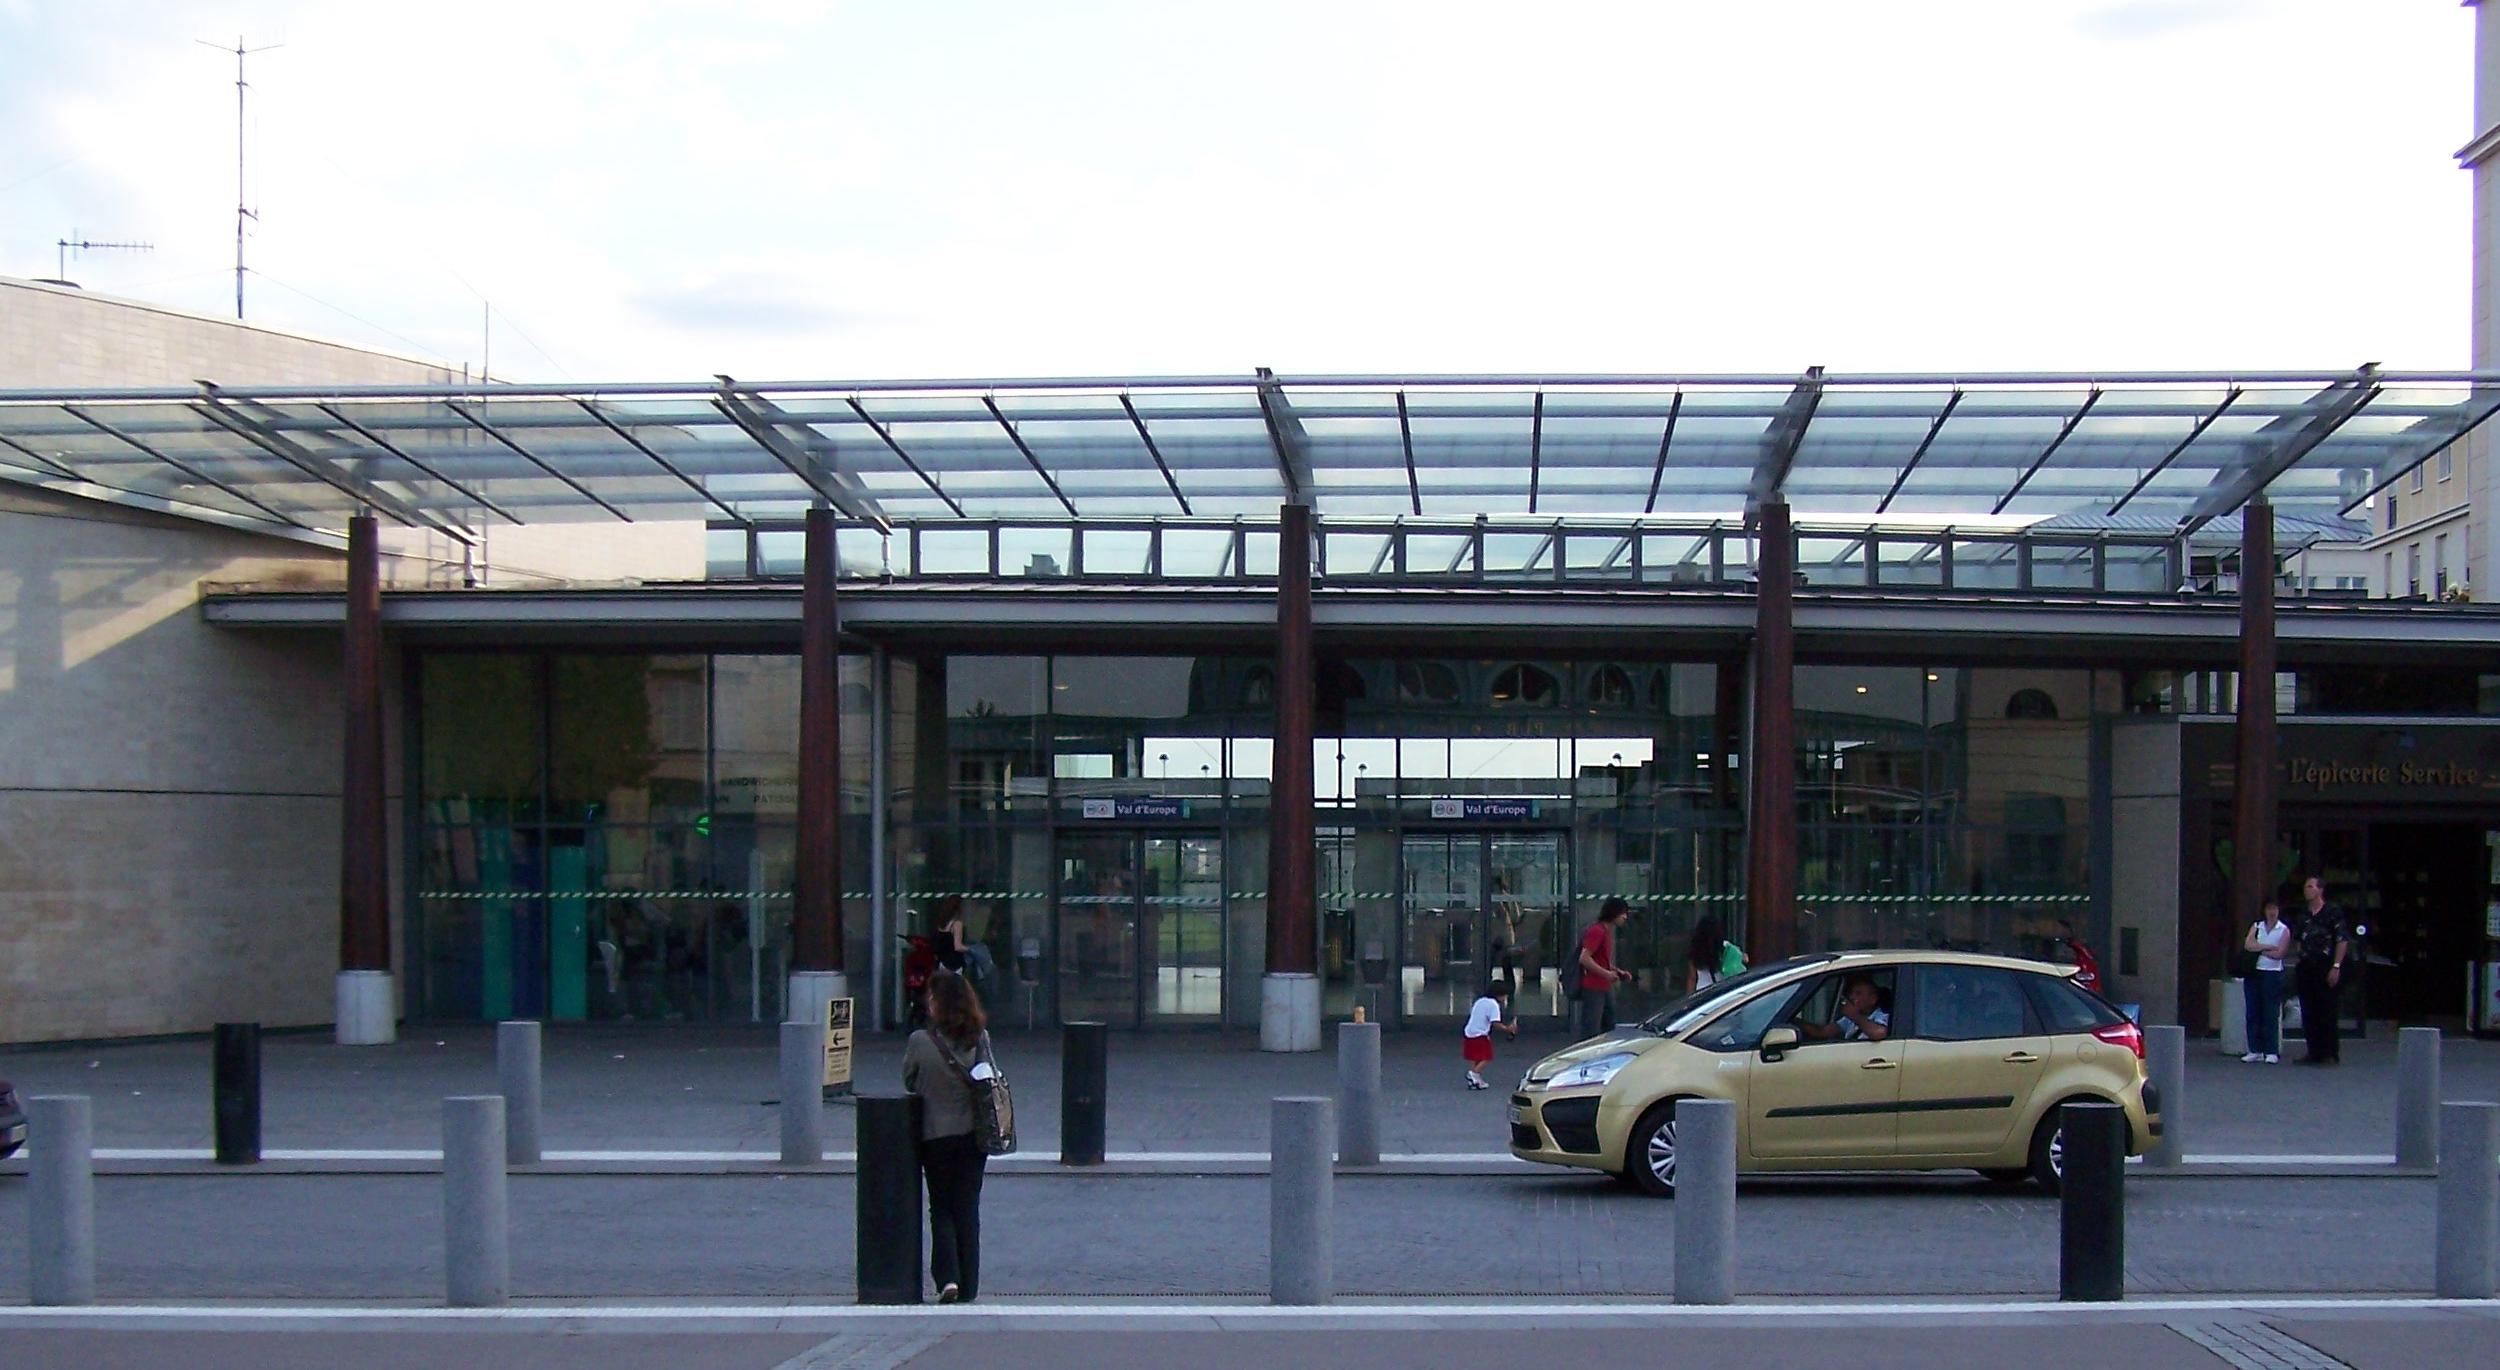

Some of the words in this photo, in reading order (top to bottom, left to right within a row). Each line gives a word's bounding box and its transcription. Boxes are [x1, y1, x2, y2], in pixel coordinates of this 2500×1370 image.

[2289, 758, 2391, 790] L'épicerie
[2400, 760, 2479, 785] Service
[1116, 805, 1133, 815] Val
[1135, 804, 1178, 817] d'Europe
[1465, 805, 1481, 815] Val
[1484, 804, 1527, 817] d'Europe
